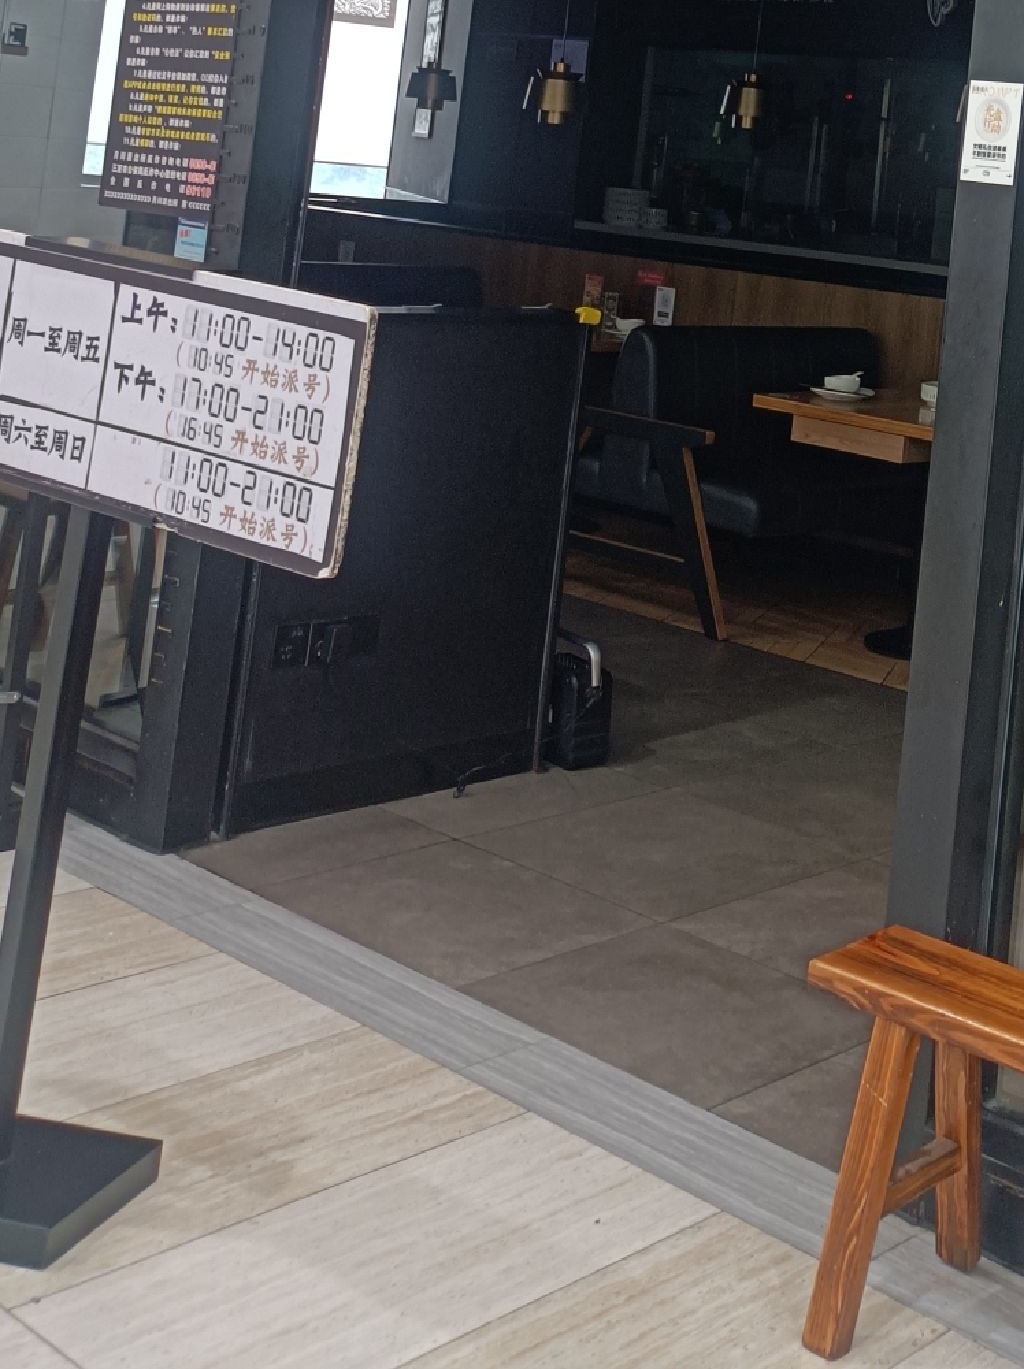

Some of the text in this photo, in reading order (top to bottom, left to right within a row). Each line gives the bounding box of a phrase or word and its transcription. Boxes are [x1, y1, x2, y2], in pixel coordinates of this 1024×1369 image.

[7, 317, 100, 363] 周一至周五
[0, 414, 86, 463] 周六至周日
